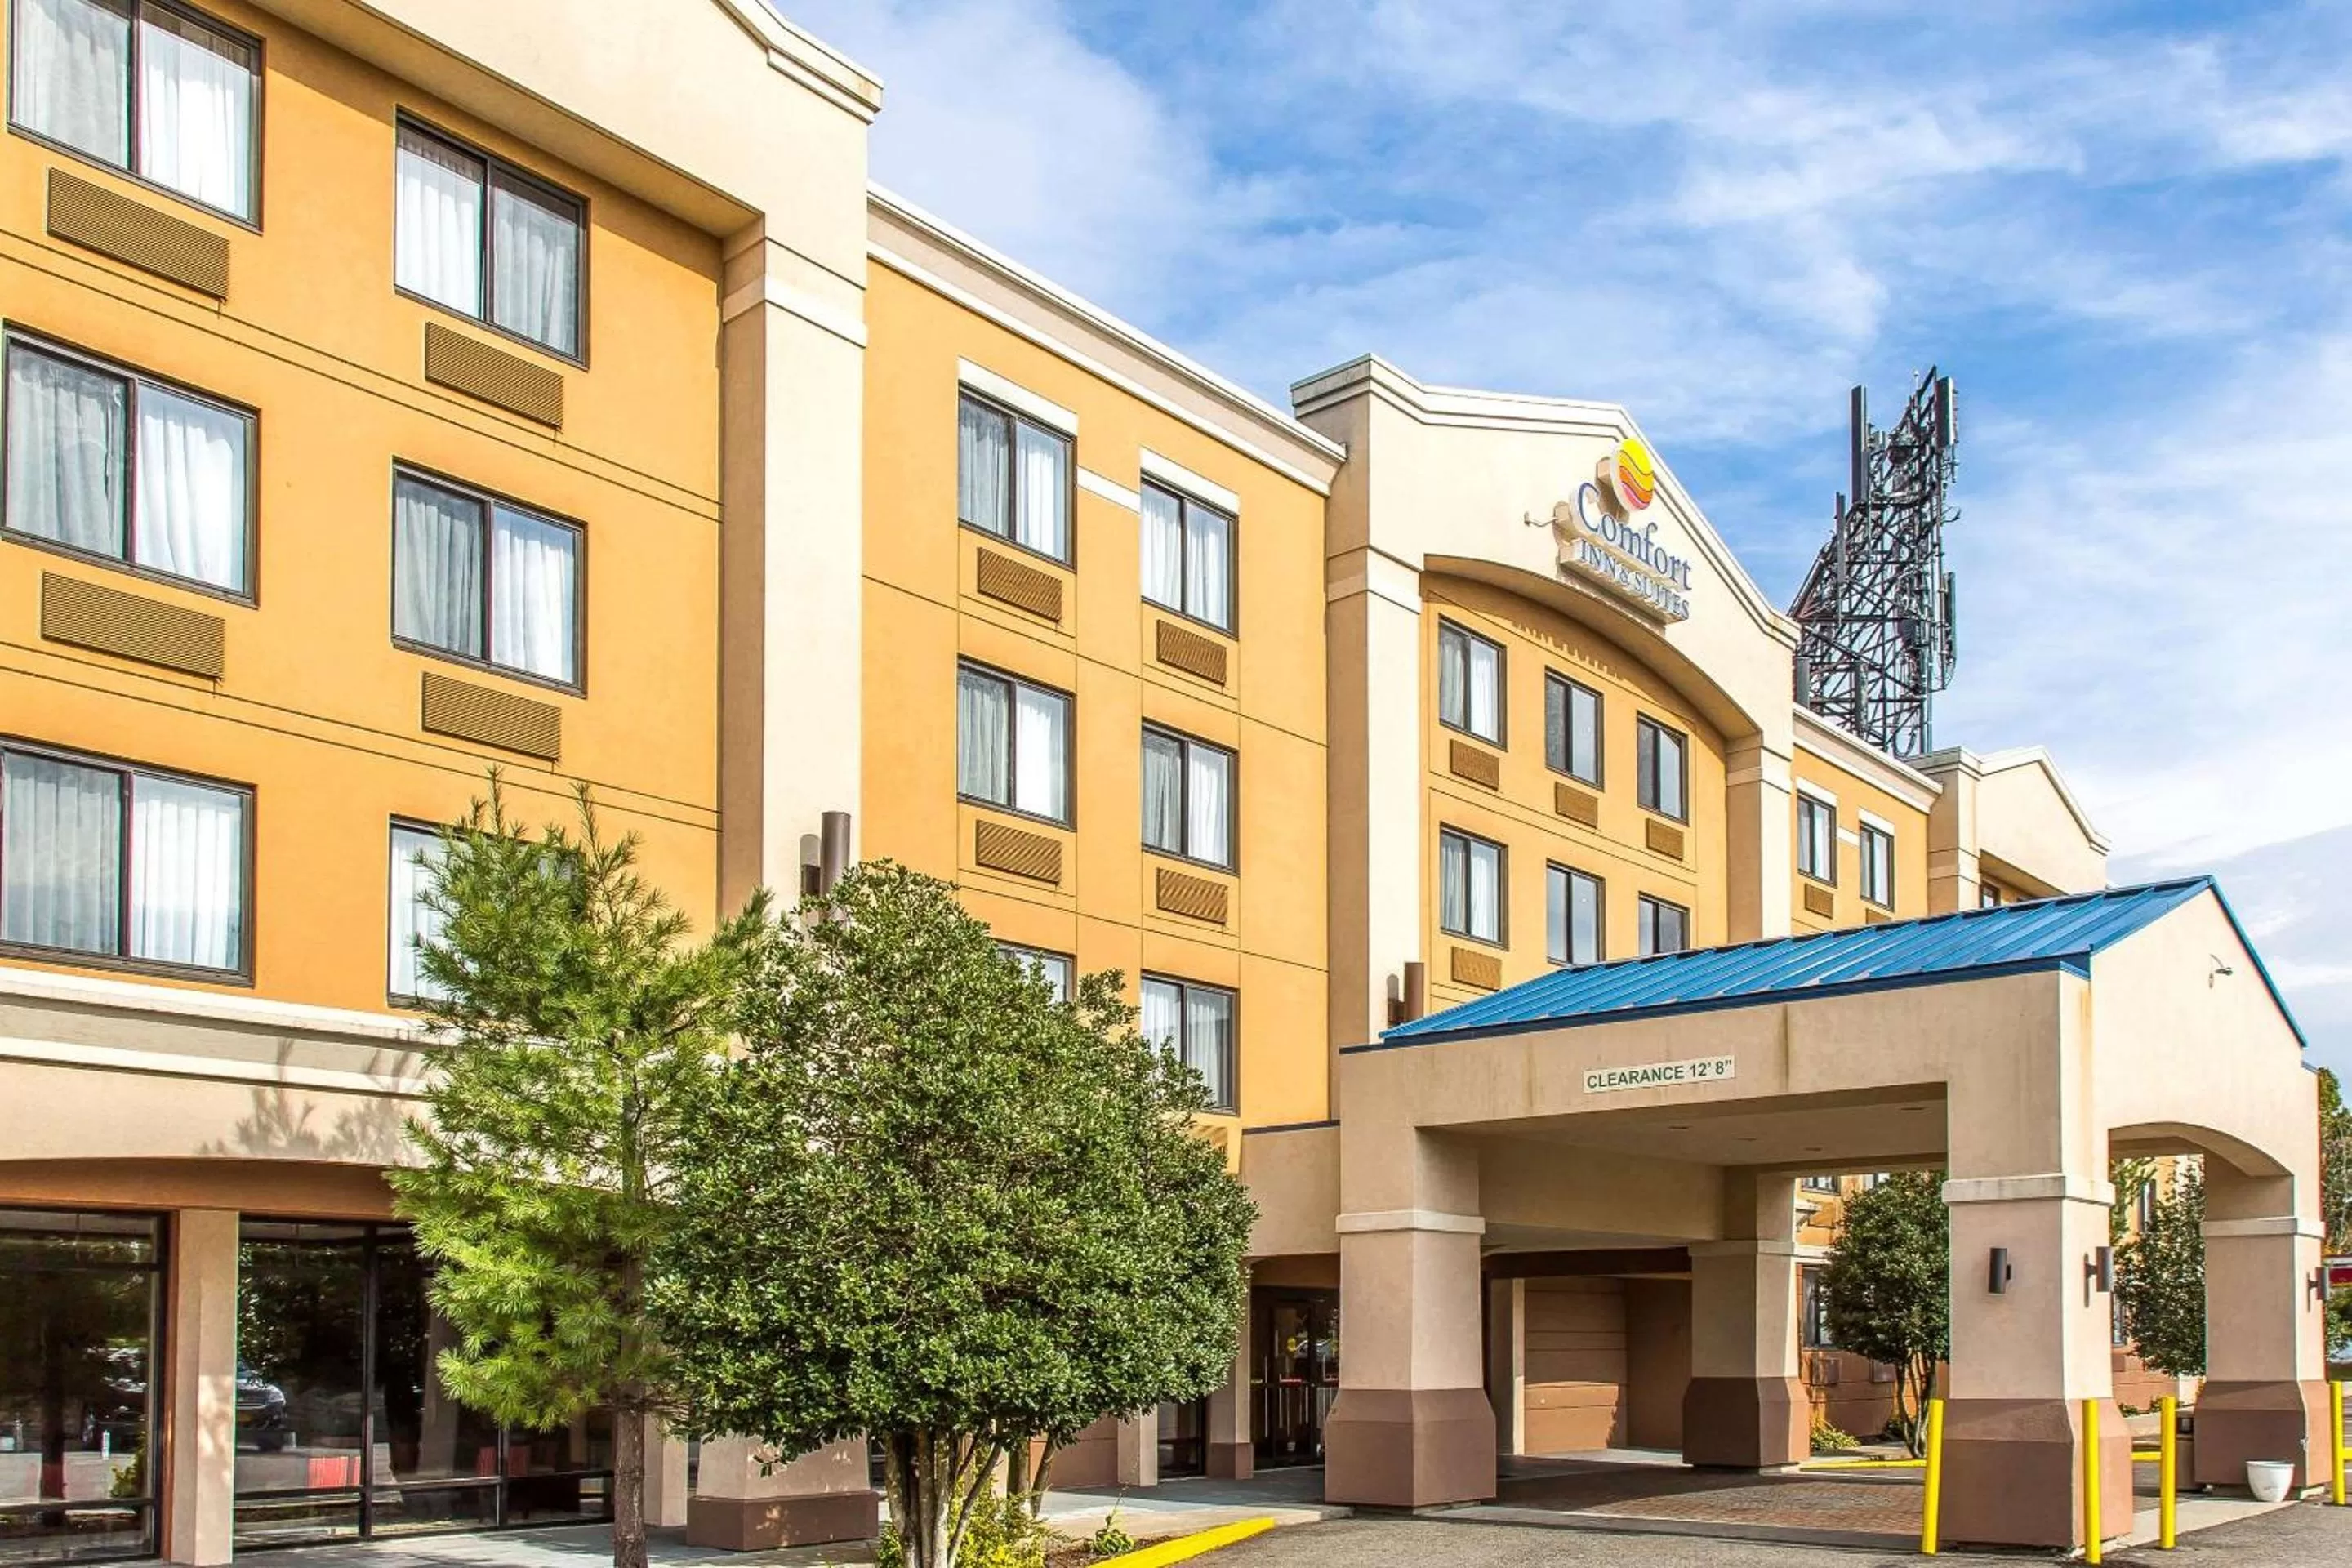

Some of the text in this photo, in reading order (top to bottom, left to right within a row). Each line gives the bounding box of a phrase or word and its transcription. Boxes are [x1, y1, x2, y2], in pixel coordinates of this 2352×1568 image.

[1577, 481, 1692, 590] Comfort
[1580, 539, 1616, 578] INN
[1633, 571, 1690, 621] SUITES
[1587, 1066, 1685, 1089] CLEARANCE
